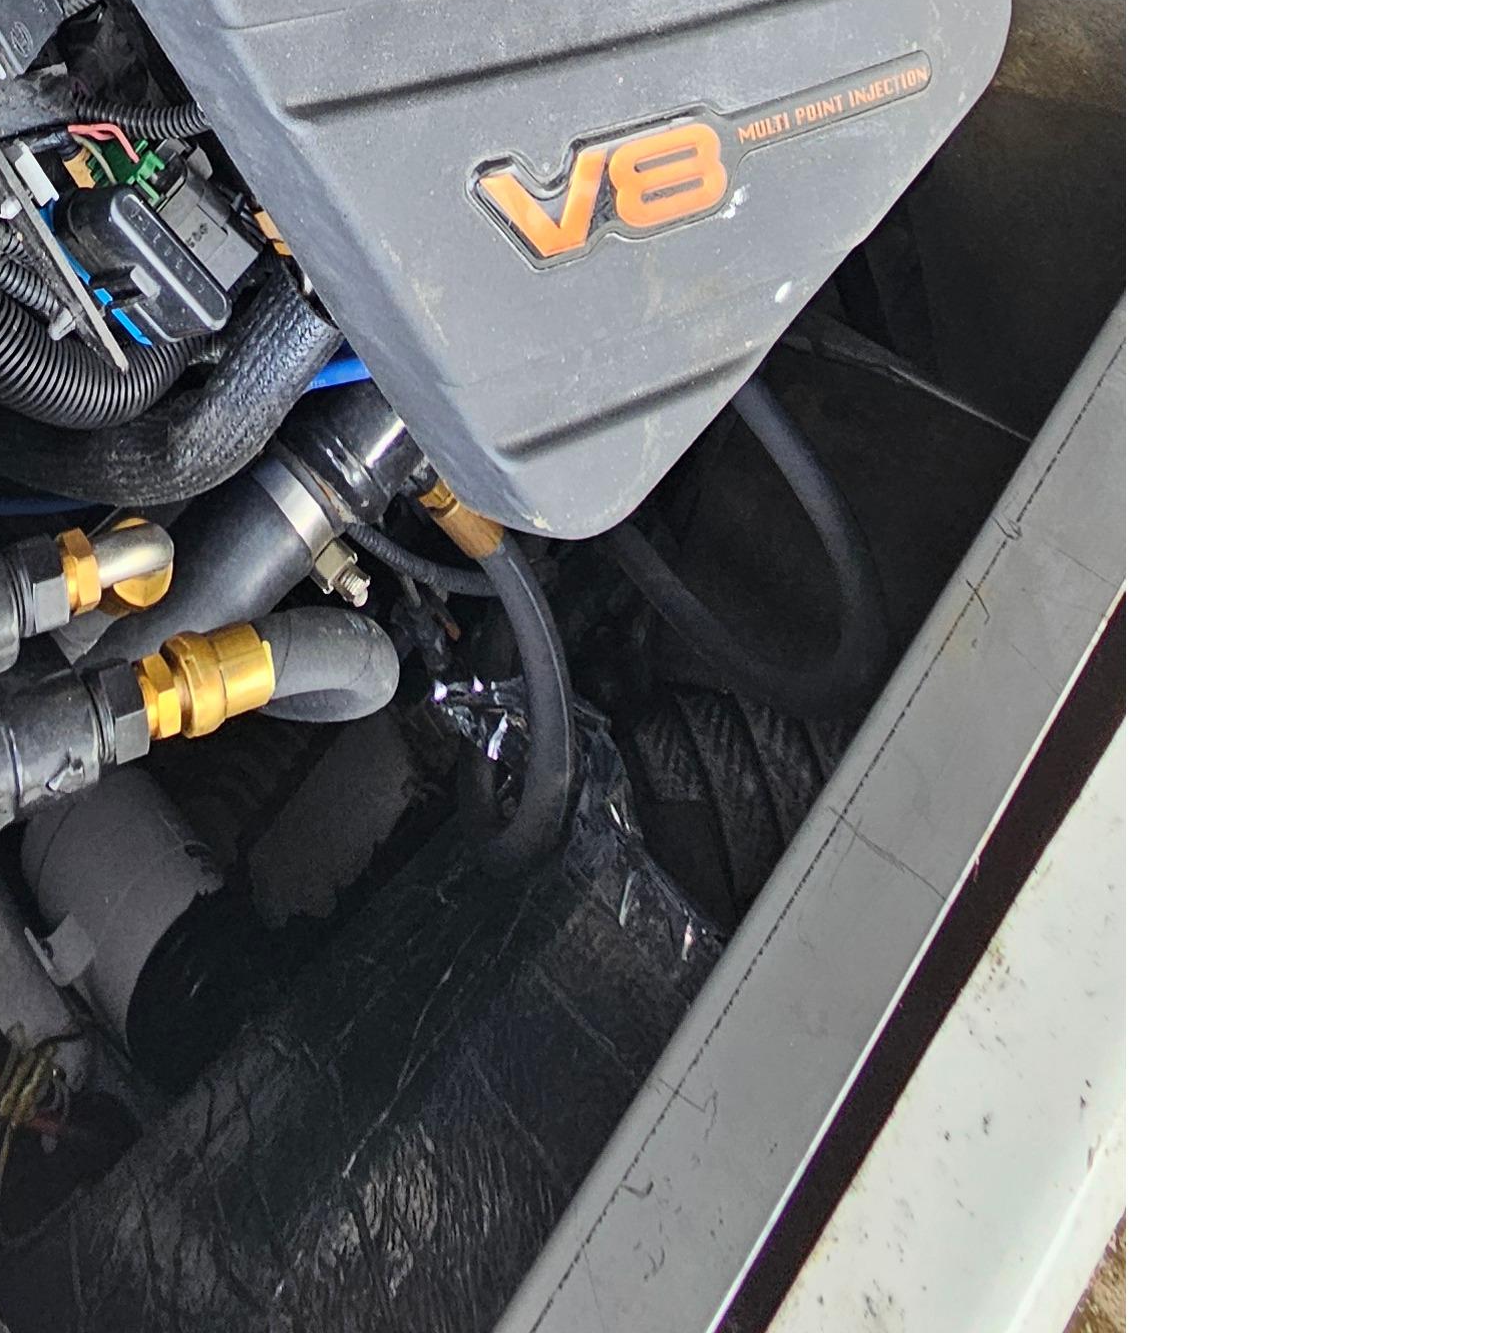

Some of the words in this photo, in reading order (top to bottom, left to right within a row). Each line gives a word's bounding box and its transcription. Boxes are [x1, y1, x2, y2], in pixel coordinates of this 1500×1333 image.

[738, 110, 791, 145] MULTI
[796, 95, 844, 127] POINT
[848, 67, 930, 112] INJECTION
[480, 124, 728, 259] V8
